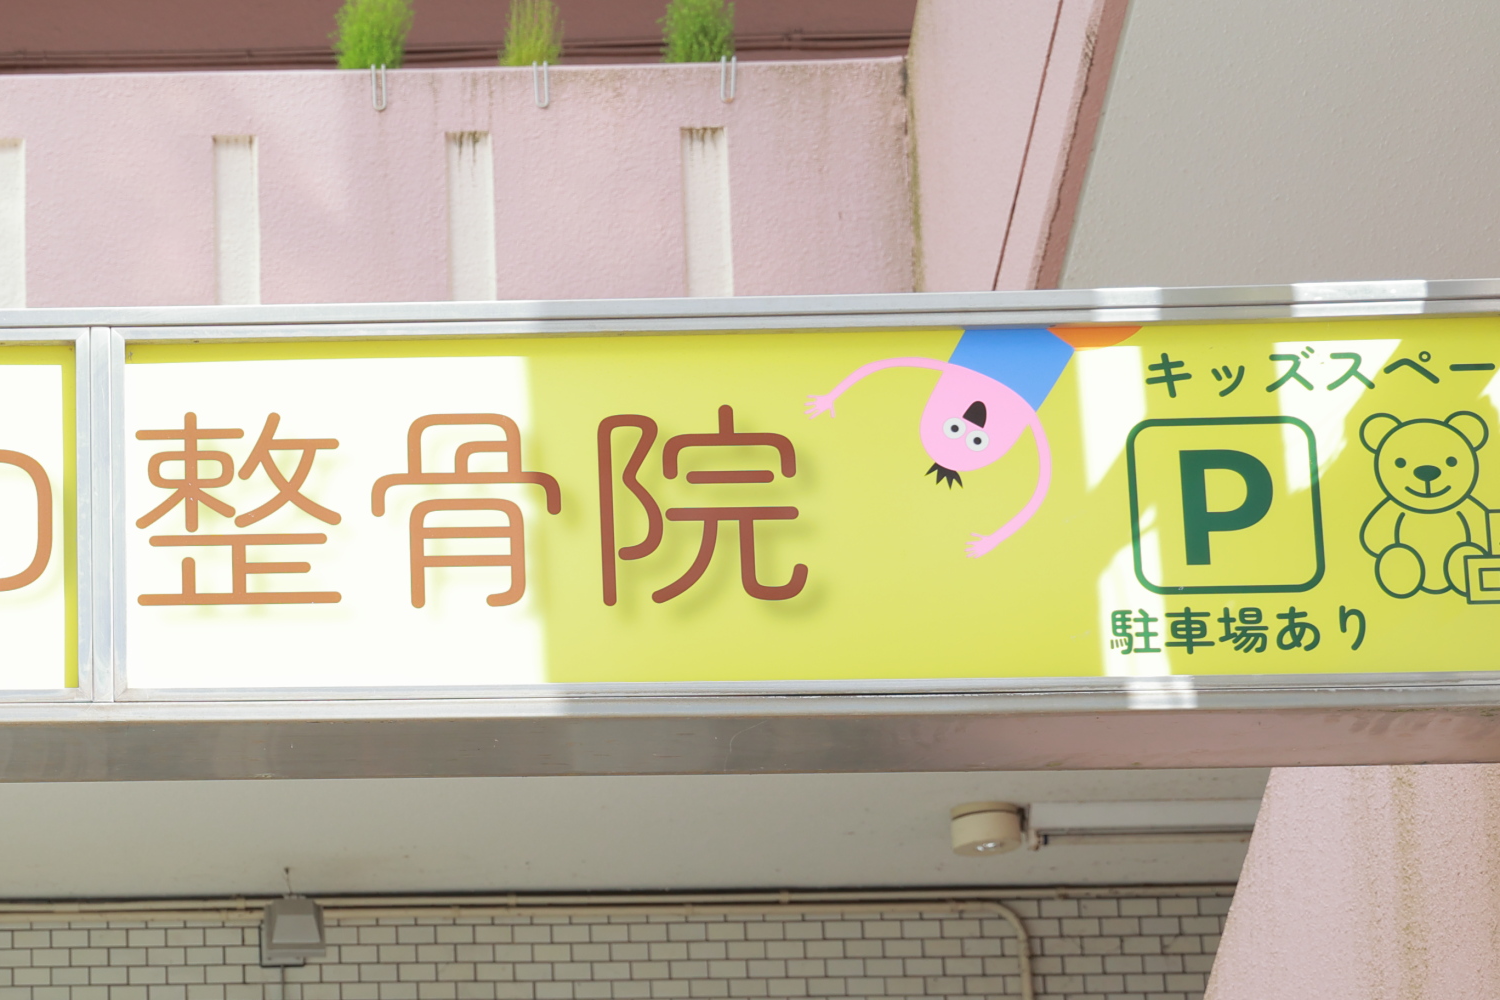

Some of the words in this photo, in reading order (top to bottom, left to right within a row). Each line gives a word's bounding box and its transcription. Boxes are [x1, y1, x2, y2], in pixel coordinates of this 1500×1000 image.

[1145, 346, 1497, 399] キッズスペー
[1178, 448, 1274, 566] P
[1109, 604, 1367, 655] 駐車場あり
